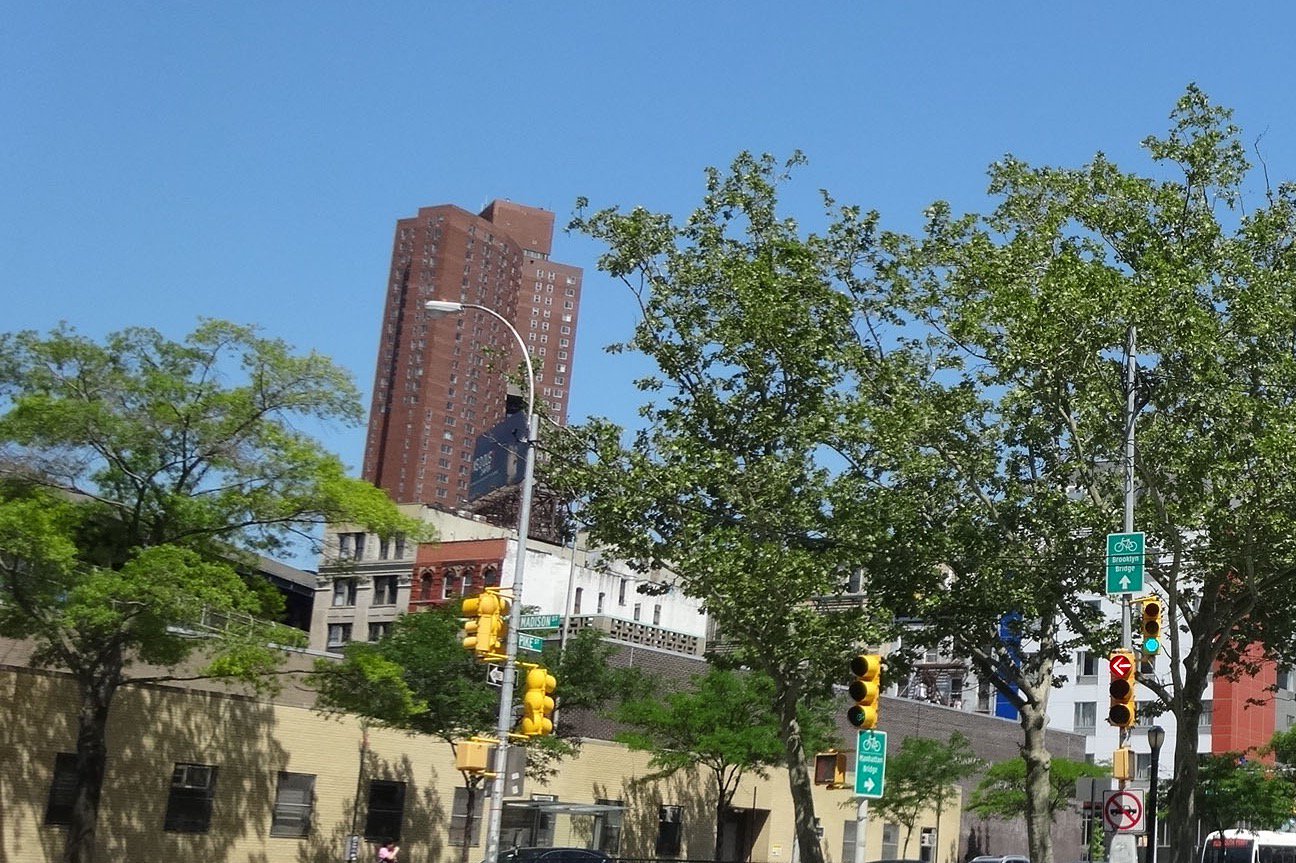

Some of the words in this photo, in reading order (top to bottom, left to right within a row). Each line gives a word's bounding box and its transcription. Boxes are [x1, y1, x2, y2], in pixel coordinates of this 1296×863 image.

[1115, 565, 1135, 573] Bridge
[520, 615, 550, 627] MADISON
[519, 635, 533, 648] PIKE
